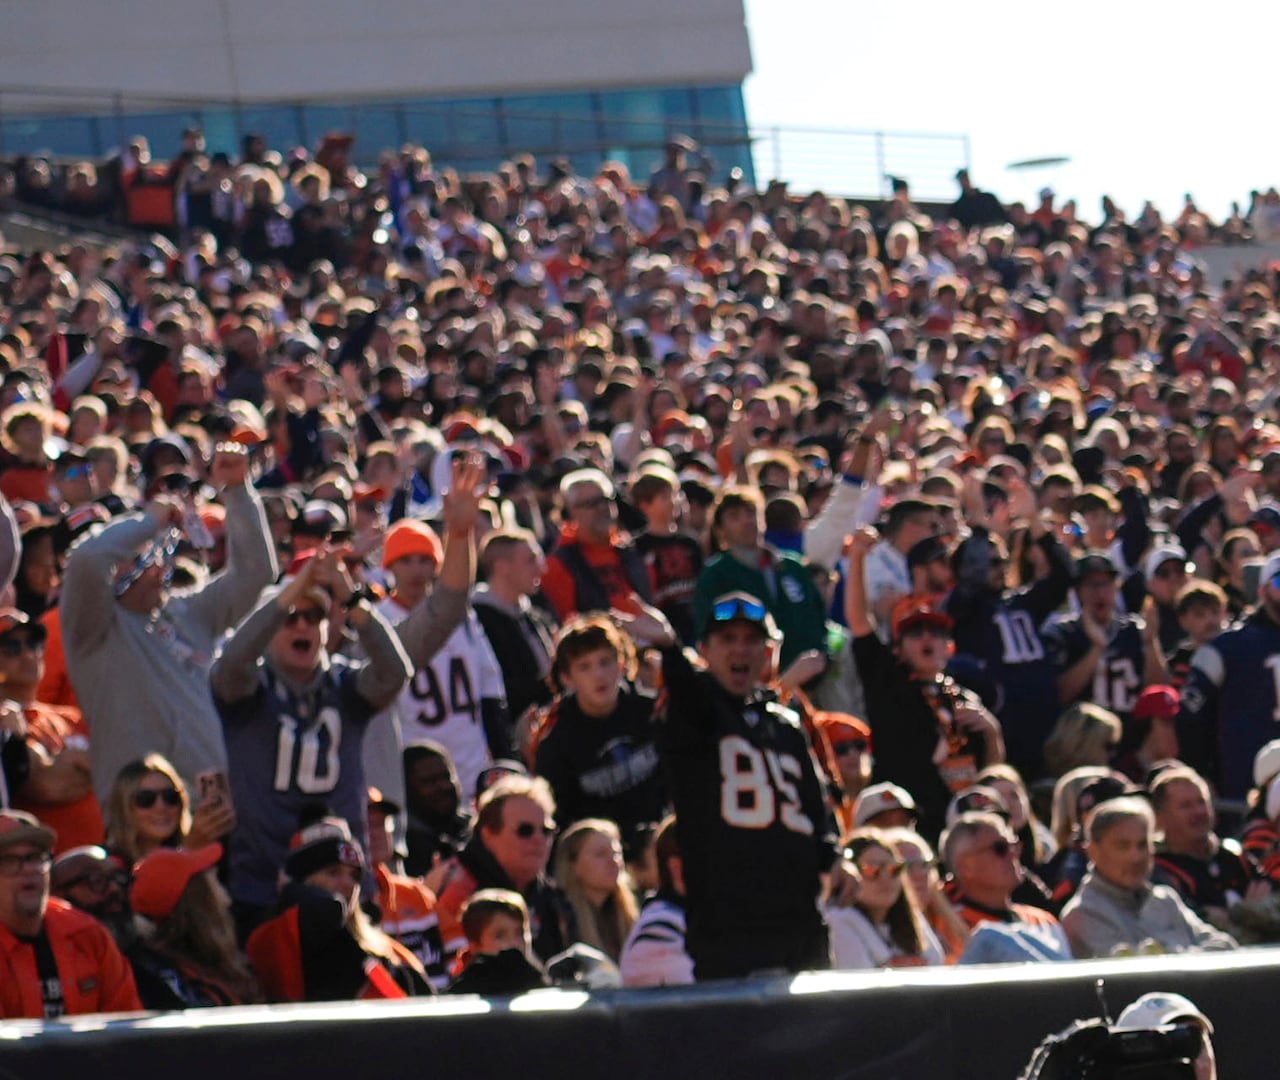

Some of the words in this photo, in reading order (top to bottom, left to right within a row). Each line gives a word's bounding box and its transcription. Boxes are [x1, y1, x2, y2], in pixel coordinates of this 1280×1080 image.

[992, 609, 1045, 665] 10
[410, 656, 476, 727] 94
[274, 706, 341, 794] 10
[719, 734, 815, 836] 85
